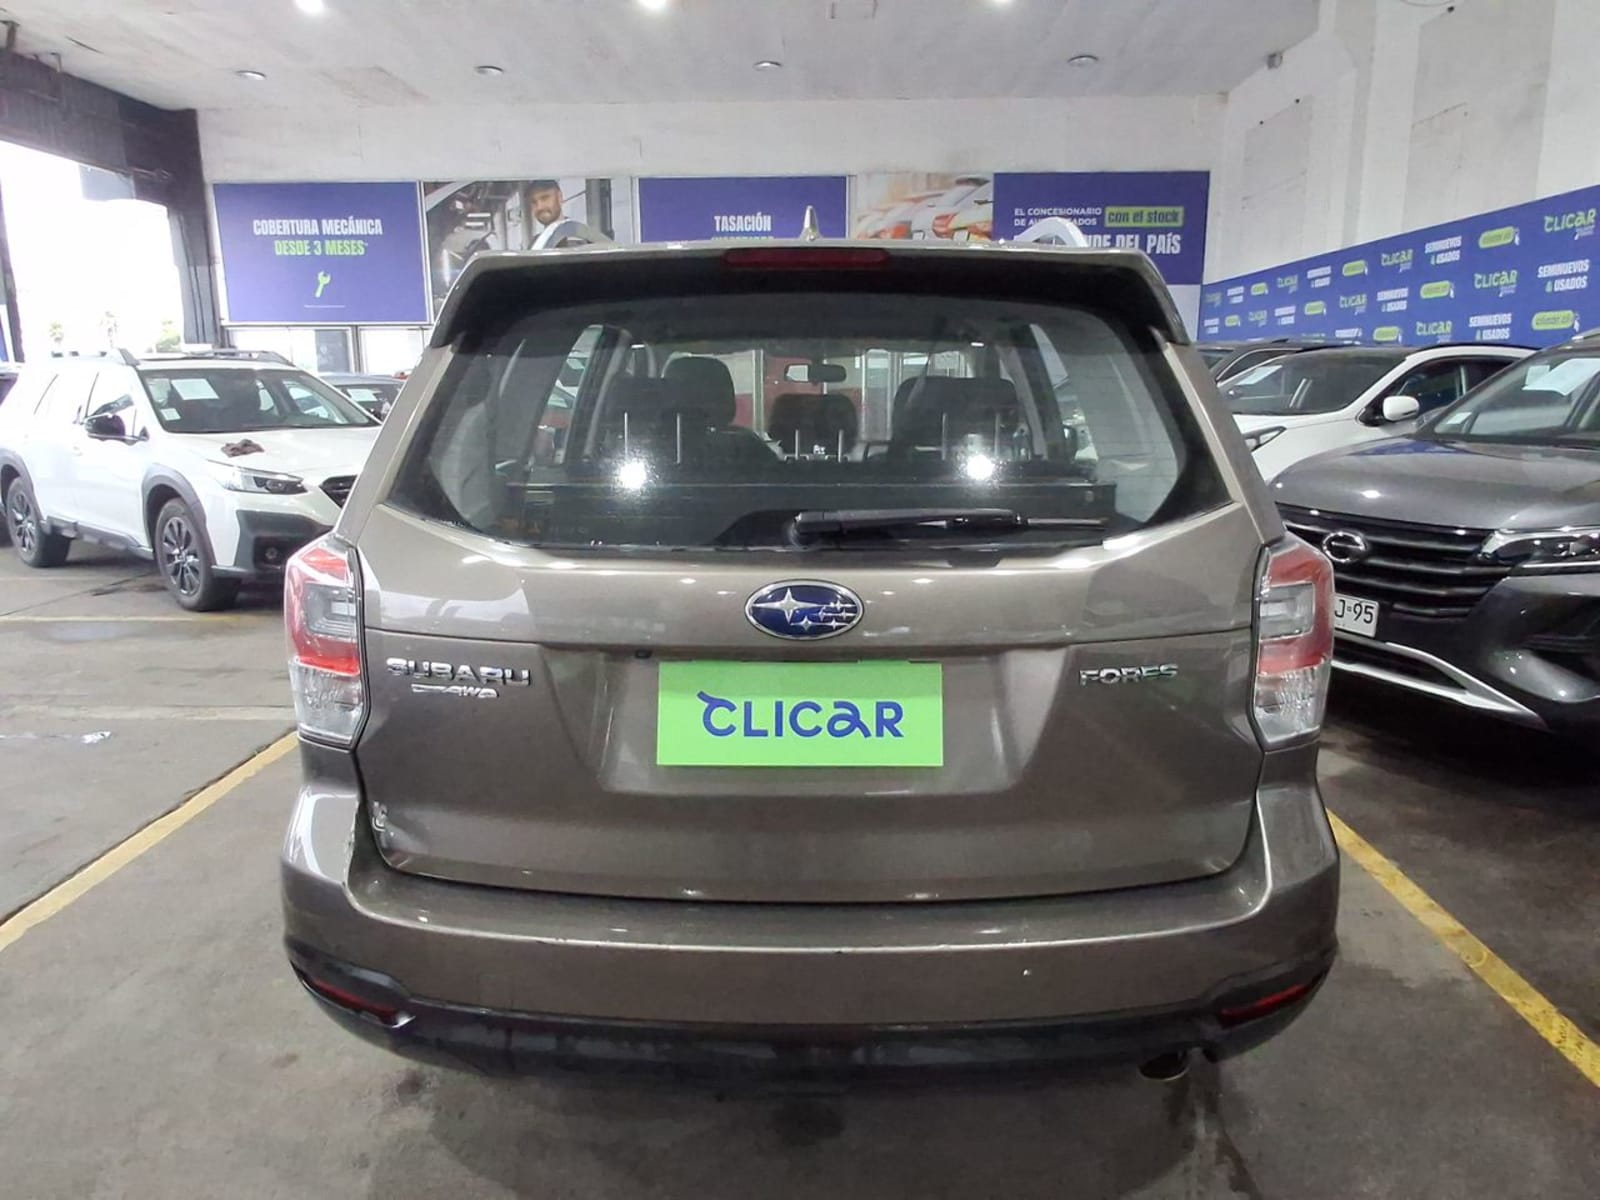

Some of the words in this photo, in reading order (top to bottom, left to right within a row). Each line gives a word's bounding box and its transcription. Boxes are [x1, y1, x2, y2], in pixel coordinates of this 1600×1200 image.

[1014, 208, 1025, 216] EL
[1027, 207, 1102, 216] CONCESIONARIO
[1108, 211, 1129, 223] con
[1133, 209, 1144, 222] el
[1149, 208, 1179, 222] stock
[253, 219, 319, 235] COBERTURA
[321, 215, 383, 235] MECÁNICA
[714, 211, 772, 231] TASACIÓN
[1014, 218, 1026, 226] DE
[274, 240, 311, 255] DESDE
[313, 240, 322, 255] 3
[1147, 232, 1182, 254] PAÍS
[1554, 276, 1588, 292] USADOS
[386, 657, 531, 686] SUBARU
[1080, 663, 1178, 686] FORES
